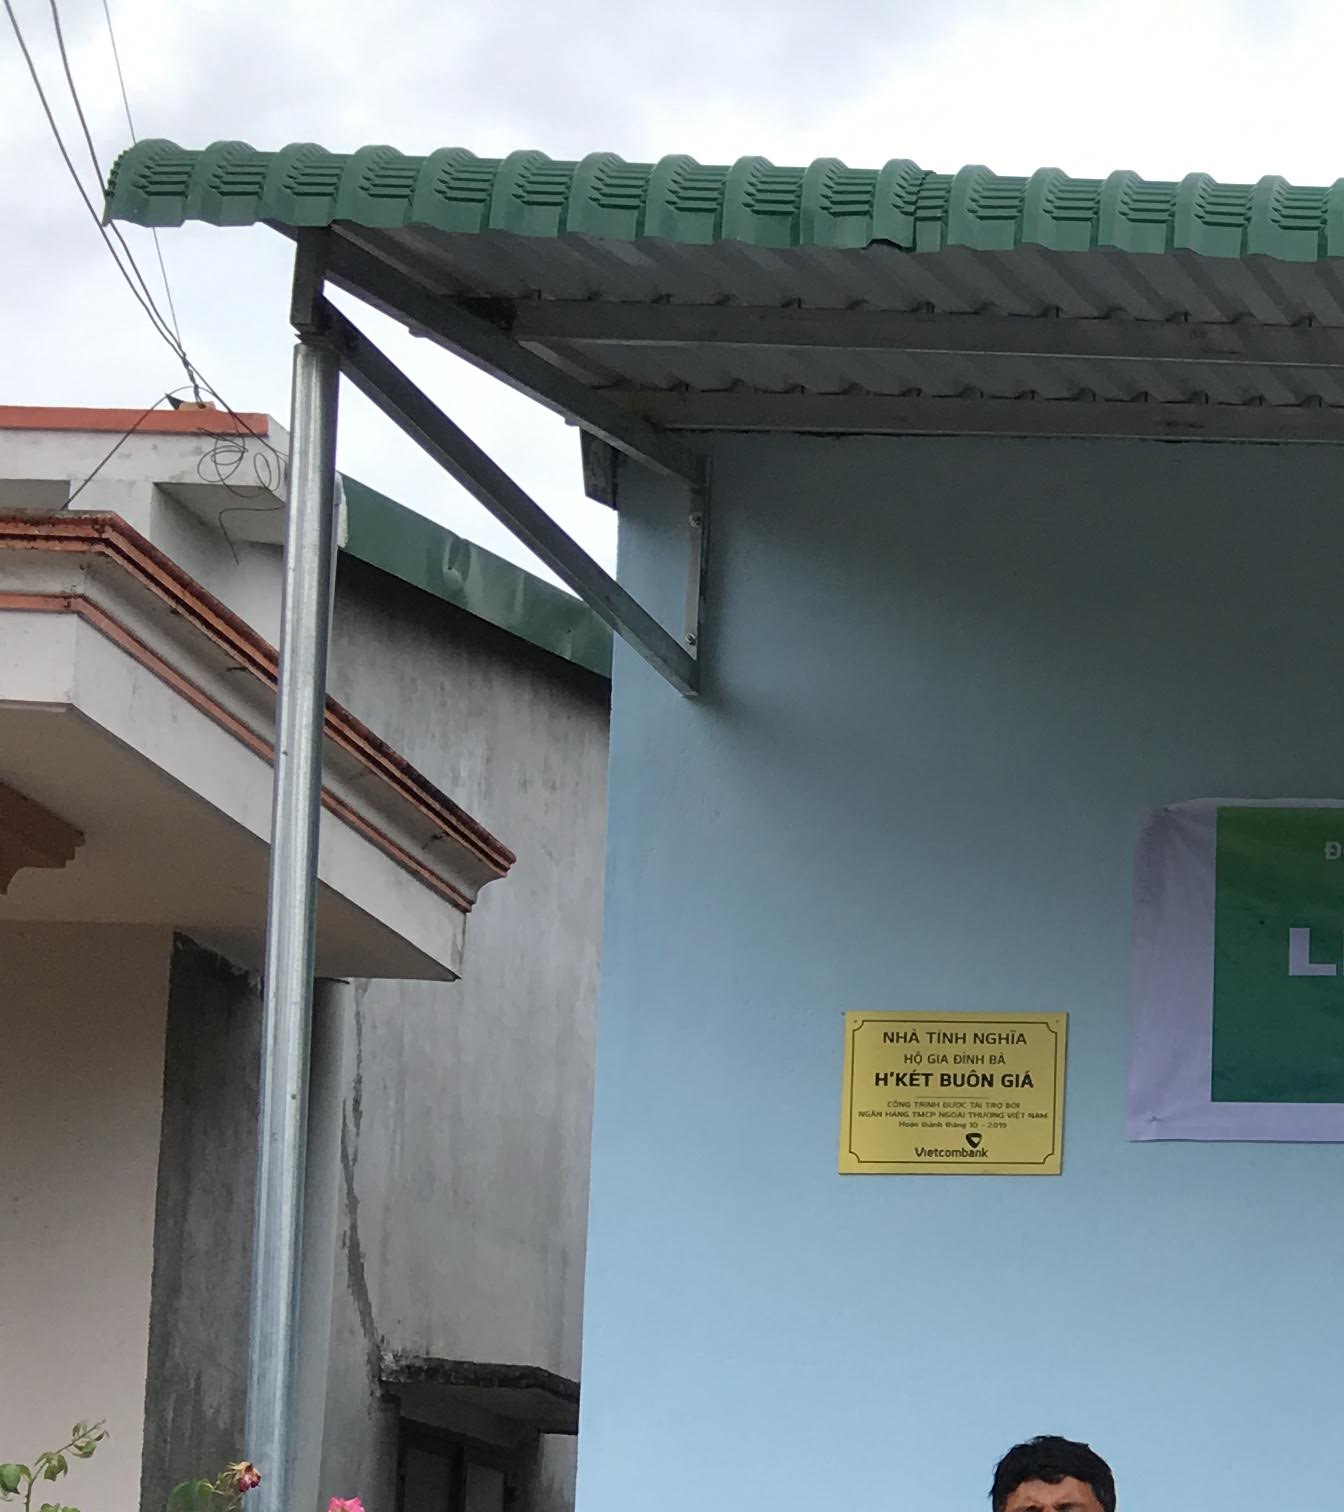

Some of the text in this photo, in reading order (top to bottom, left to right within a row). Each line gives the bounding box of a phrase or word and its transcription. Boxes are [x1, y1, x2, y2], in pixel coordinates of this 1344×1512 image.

[883, 1029, 1027, 1045] NHÀ TÌNH NGHĨA
[904, 1051, 1006, 1065] HỘ GIA ĐÌNH BÀ
[940, 1069, 994, 1088] BUÔN
[1001, 1070, 1034, 1088] GIÁ
[914, 1147, 989, 1158] Vietcombank
